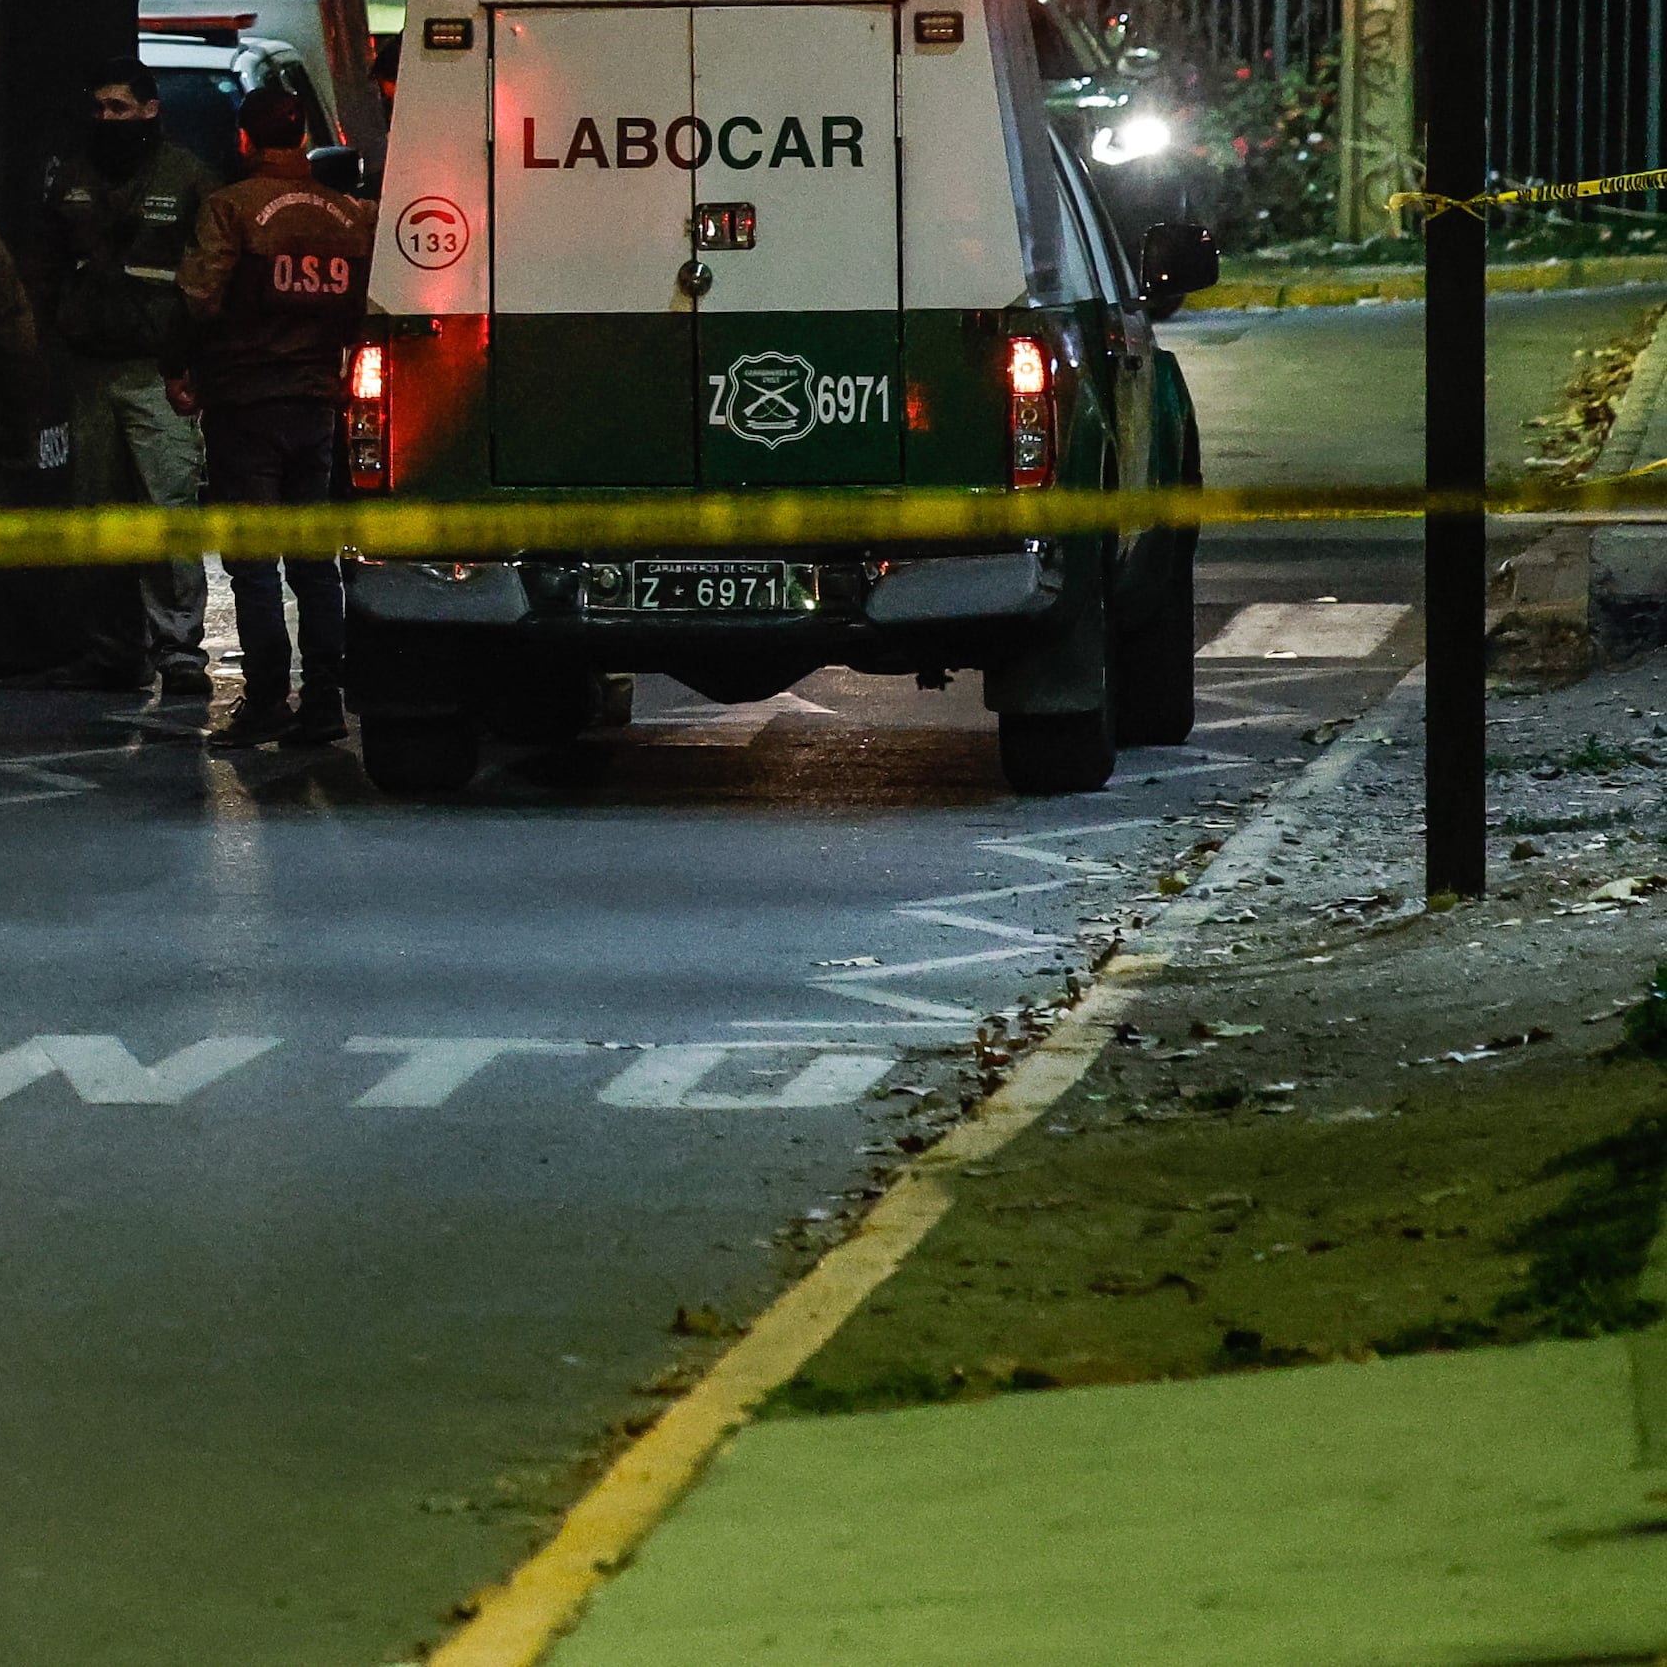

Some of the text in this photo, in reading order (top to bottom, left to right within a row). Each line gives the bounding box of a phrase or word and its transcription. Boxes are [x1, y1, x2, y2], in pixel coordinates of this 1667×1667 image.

[523, 116, 864, 170] LABOCAR
[410, 234, 457, 253] 133
[273, 254, 350, 294] O.S.9
[709, 375, 889, 425] Z 6971
[648, 564, 770, 574] CARABINEROS DE CHILE
[641, 577, 777, 608] Z 6971
